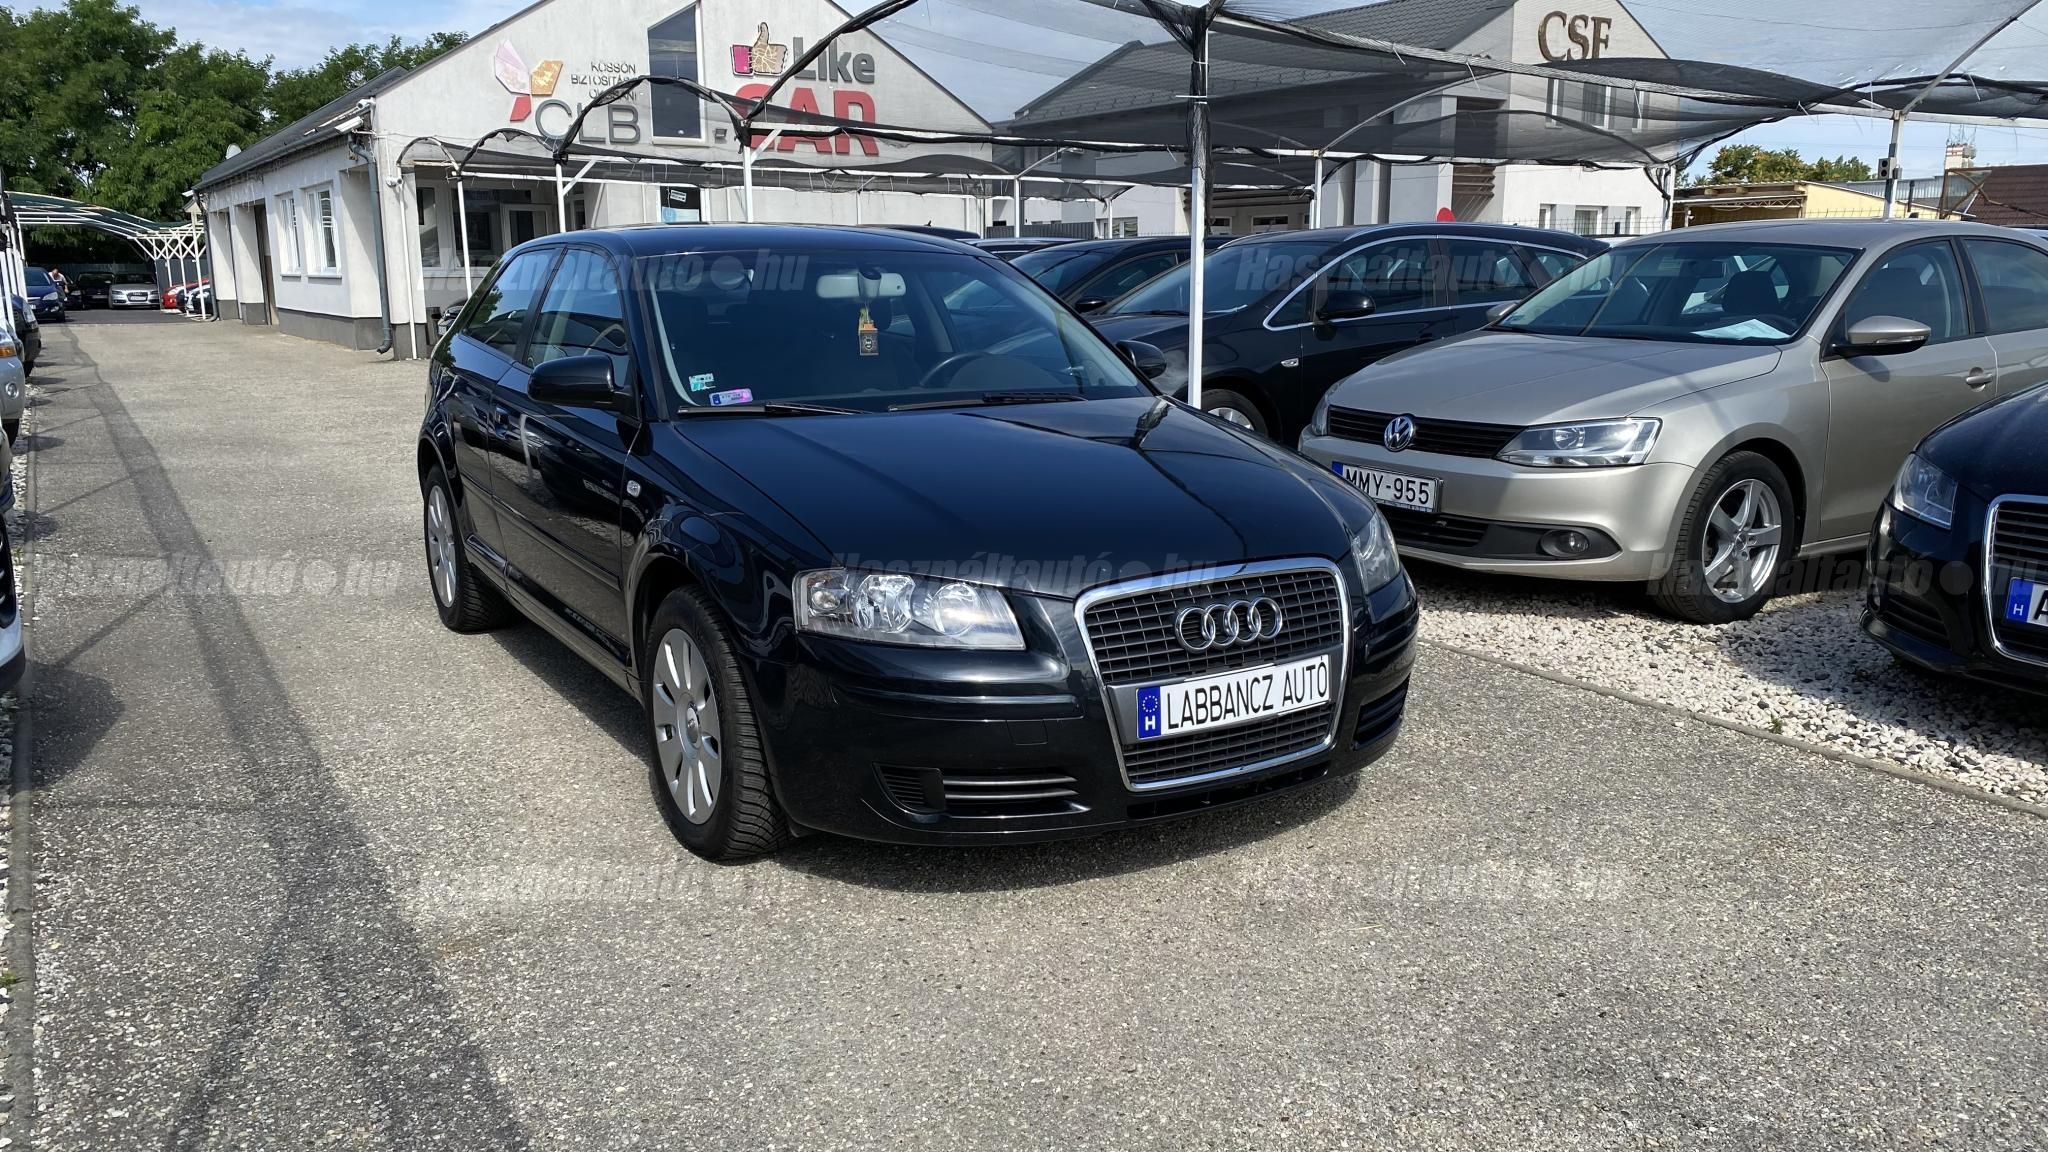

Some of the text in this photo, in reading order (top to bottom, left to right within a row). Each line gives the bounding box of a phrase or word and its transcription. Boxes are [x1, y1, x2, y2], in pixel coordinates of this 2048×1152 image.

[1538, 10, 1612, 61] CSF
[793, 37, 875, 84] Like
[535, 98, 641, 145] CLB
[1346, 468, 1430, 505] MMY-955
[2012, 603, 2024, 616] H
[1167, 655, 1328, 730] LABBANCZ AUTÓ
[1144, 716, 1156, 731] H
